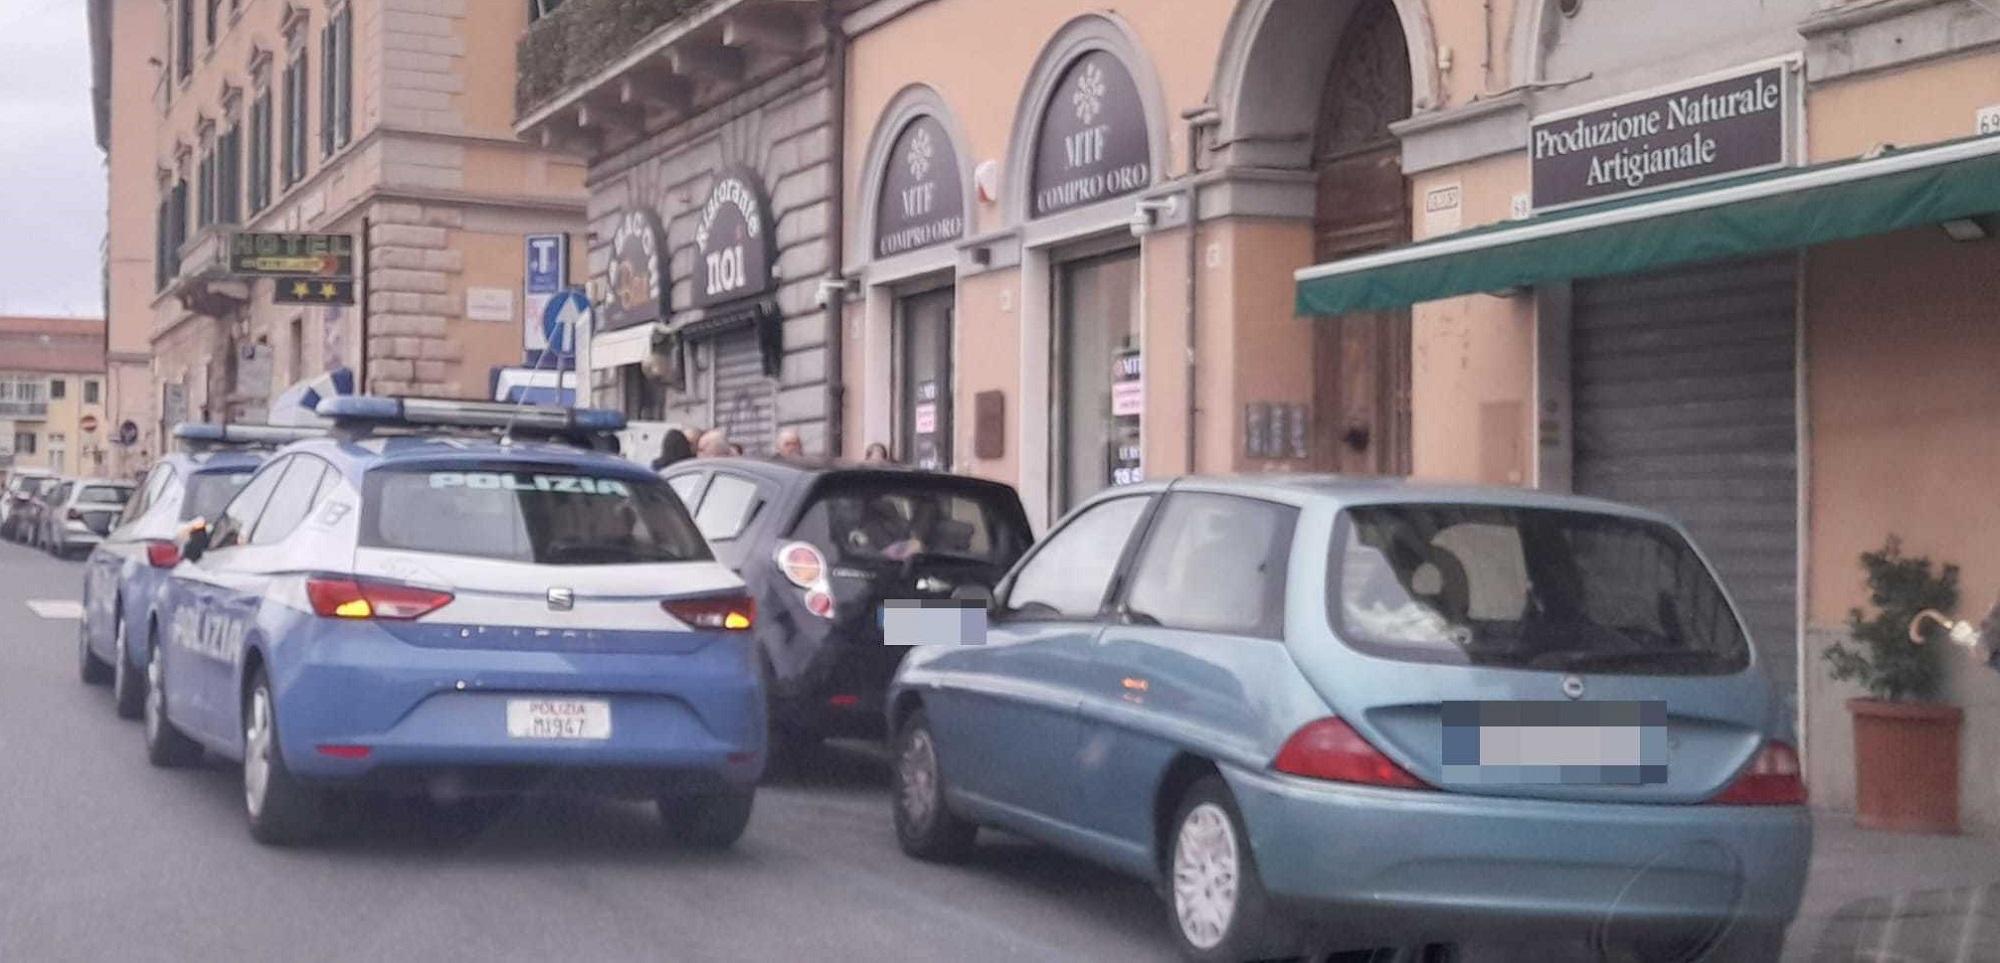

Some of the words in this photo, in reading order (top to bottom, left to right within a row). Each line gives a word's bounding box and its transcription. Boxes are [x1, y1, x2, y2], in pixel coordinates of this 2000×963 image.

[1534, 112, 1660, 159] Produzione
[1666, 77, 1779, 131] Naturale
[1065, 126, 1109, 170] MTF
[1586, 132, 1716, 187] Artigianale
[902, 182, 934, 217] MTF
[1037, 175, 1104, 213] COMPRO
[1106, 162, 1148, 194] ORO
[232, 234, 350, 256] HOTEL
[880, 223, 932, 255] COMPRO
[932, 217, 961, 241] ORO
[532, 241, 555, 274] T
[706, 236, 746, 294] noi
[429, 472, 630, 497] POLIZIA
[173, 604, 241, 666] POLIZIA
[530, 702, 586, 716] POLIZIA
